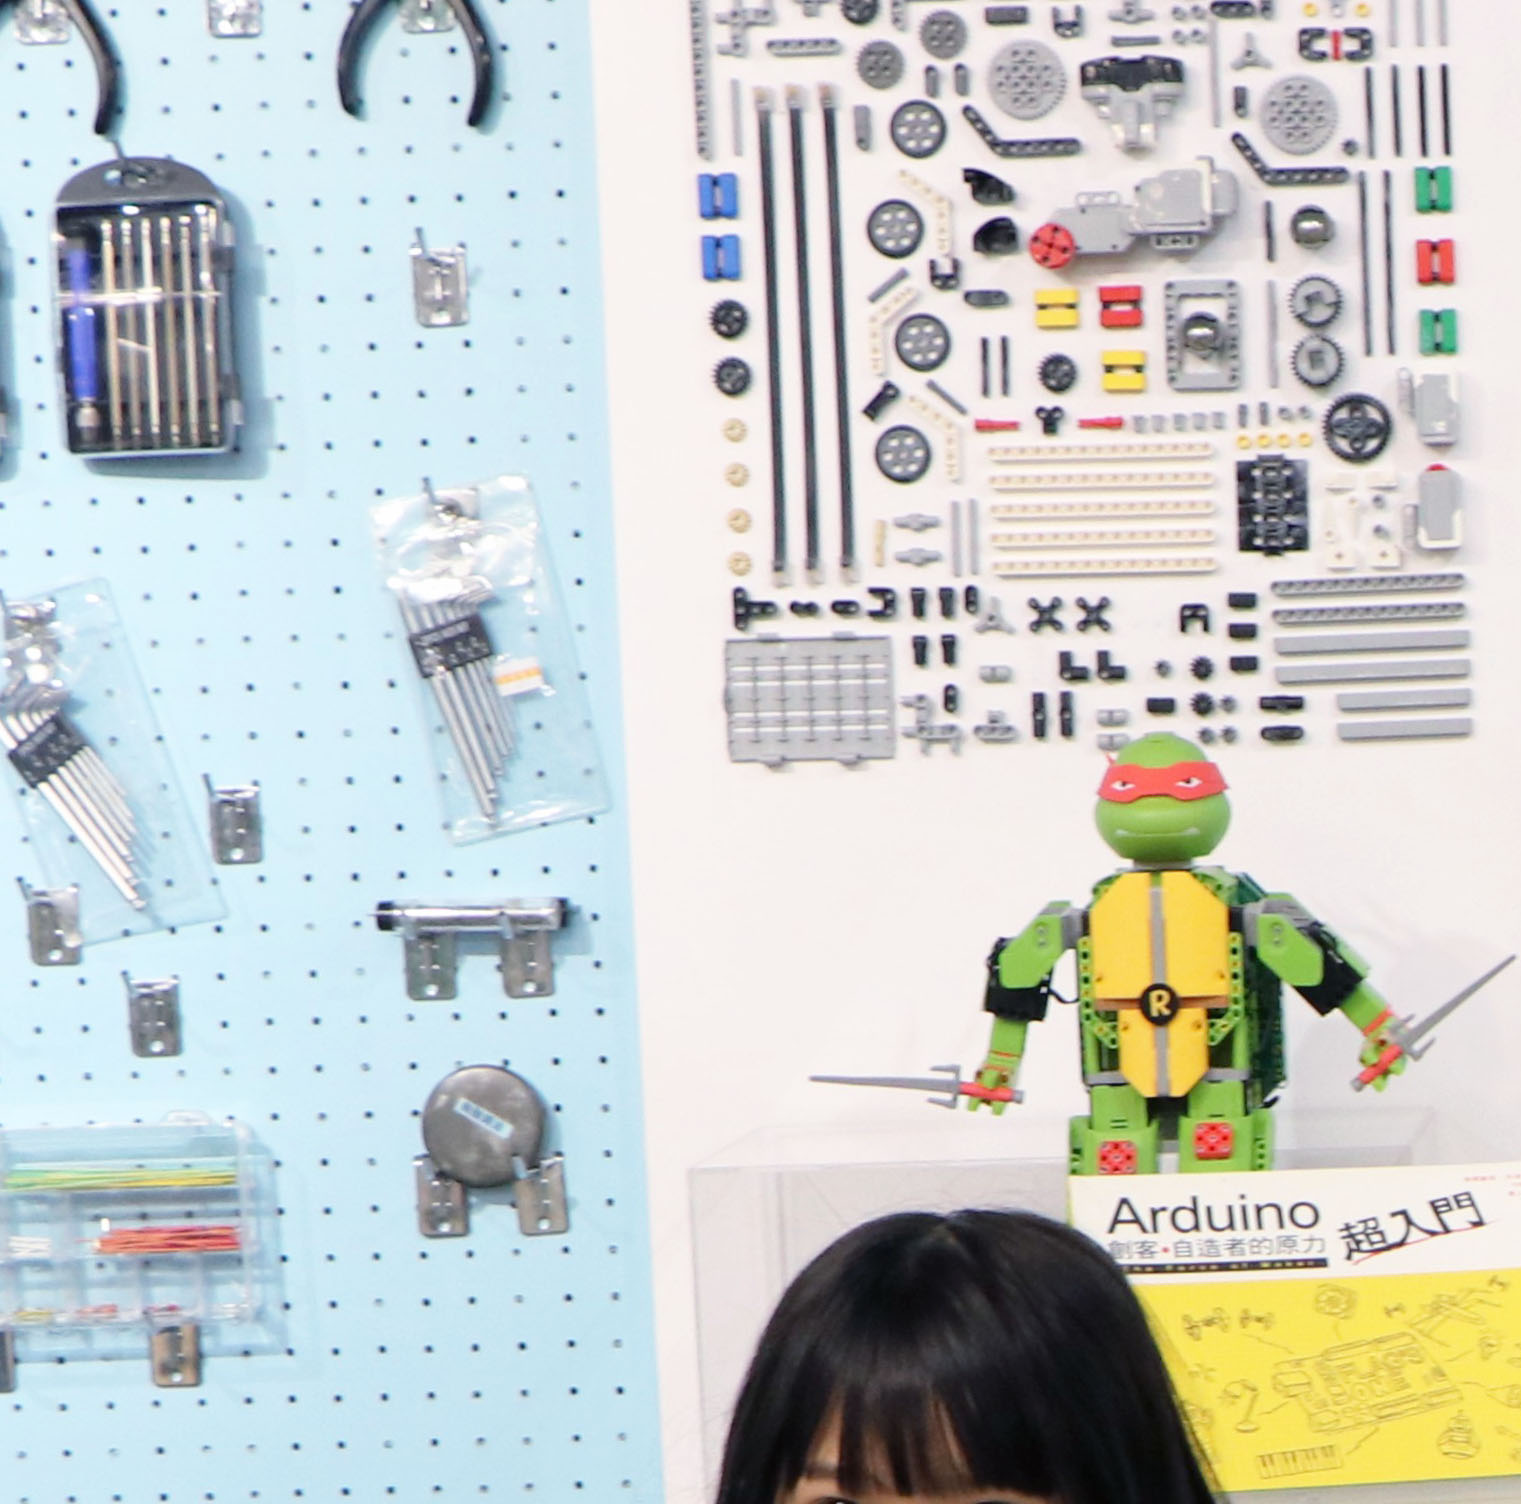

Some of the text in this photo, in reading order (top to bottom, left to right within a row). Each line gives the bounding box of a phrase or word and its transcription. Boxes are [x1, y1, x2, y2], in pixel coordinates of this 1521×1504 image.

[1147, 988, 1171, 1018] R
[1107, 1194, 1321, 1235] Arduino
[1338, 1191, 1488, 1261] 超入門
